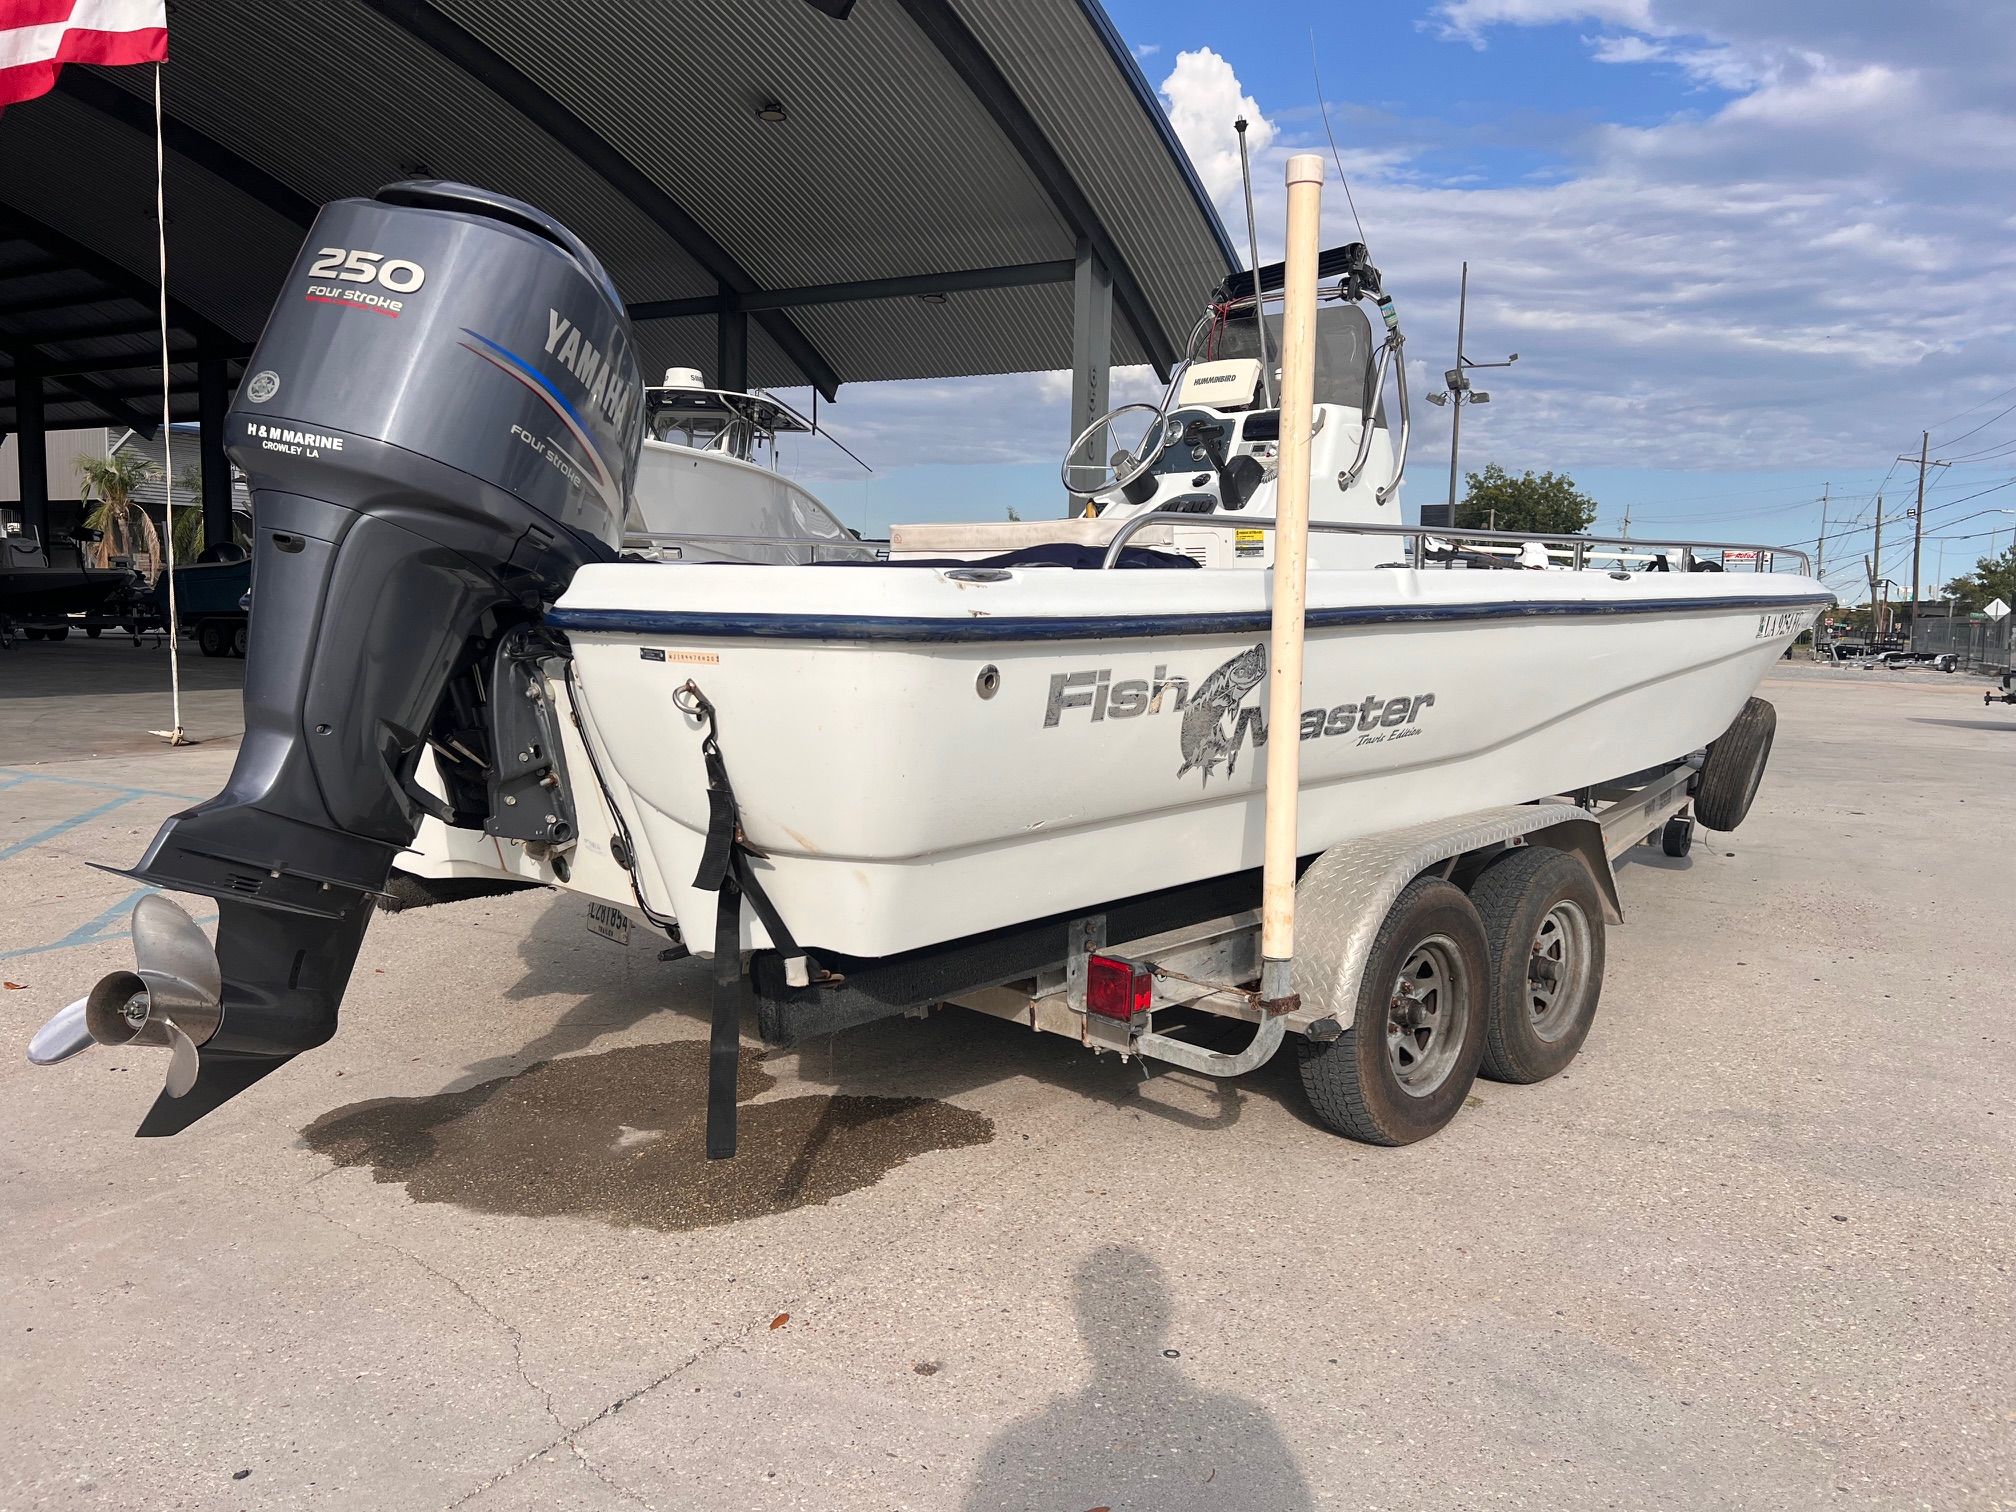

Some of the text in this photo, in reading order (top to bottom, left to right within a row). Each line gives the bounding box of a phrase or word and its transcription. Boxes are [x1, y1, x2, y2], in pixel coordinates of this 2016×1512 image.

[309, 247, 425, 294] 250
[545, 308, 629, 432] YAMAHA
[1193, 374, 1237, 386] HUMMINBIRD
[247, 422, 344, 451] H & M MARINE
[262, 440, 319, 458] CROWLEY LA
[1043, 664, 1190, 729] Fish
[1356, 727, 1422, 747] Travis Edition
